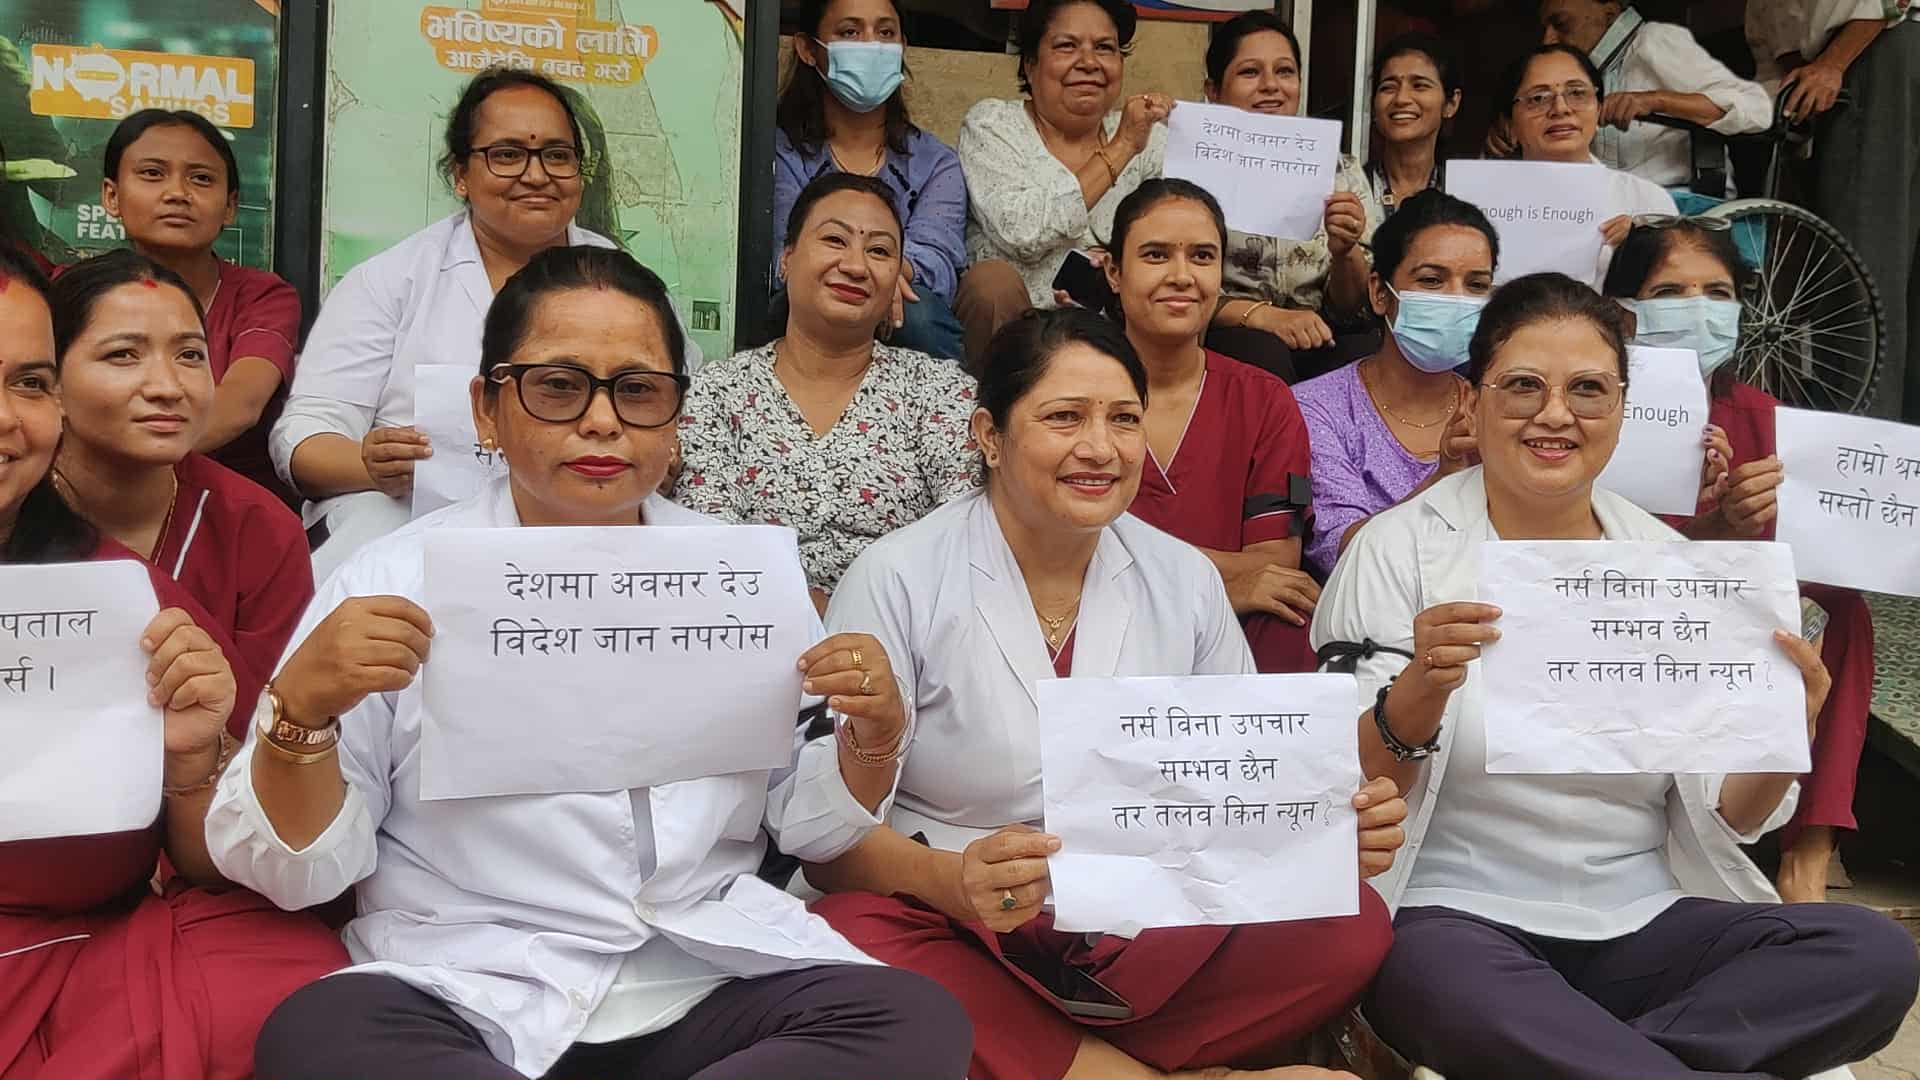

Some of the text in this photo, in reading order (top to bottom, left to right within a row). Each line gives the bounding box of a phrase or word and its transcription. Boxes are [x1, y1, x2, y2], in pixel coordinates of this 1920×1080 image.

[1480, 203, 1595, 224] nough is Enough
[1818, 487, 1919, 527] सस्तो छैन
[503, 560, 763, 600] देशमा अवसर देउ
[1552, 569, 1593, 599] नर्स
[1666, 577, 1748, 600] उपचार
[0, 610, 98, 639] पताल
[489, 614, 775, 656] विदेश जान नपरोस
[1590, 612, 1711, 643] सम्भव छैन
[1545, 661, 1581, 683] तर
[1653, 653, 1702, 684] किन
[1119, 706, 1158, 738] नर्स
[1229, 712, 1311, 736] उपचार
[1158, 749, 1279, 784] सम्भव छैन
[1112, 805, 1147, 830] तर
[1223, 795, 1269, 826] किन
